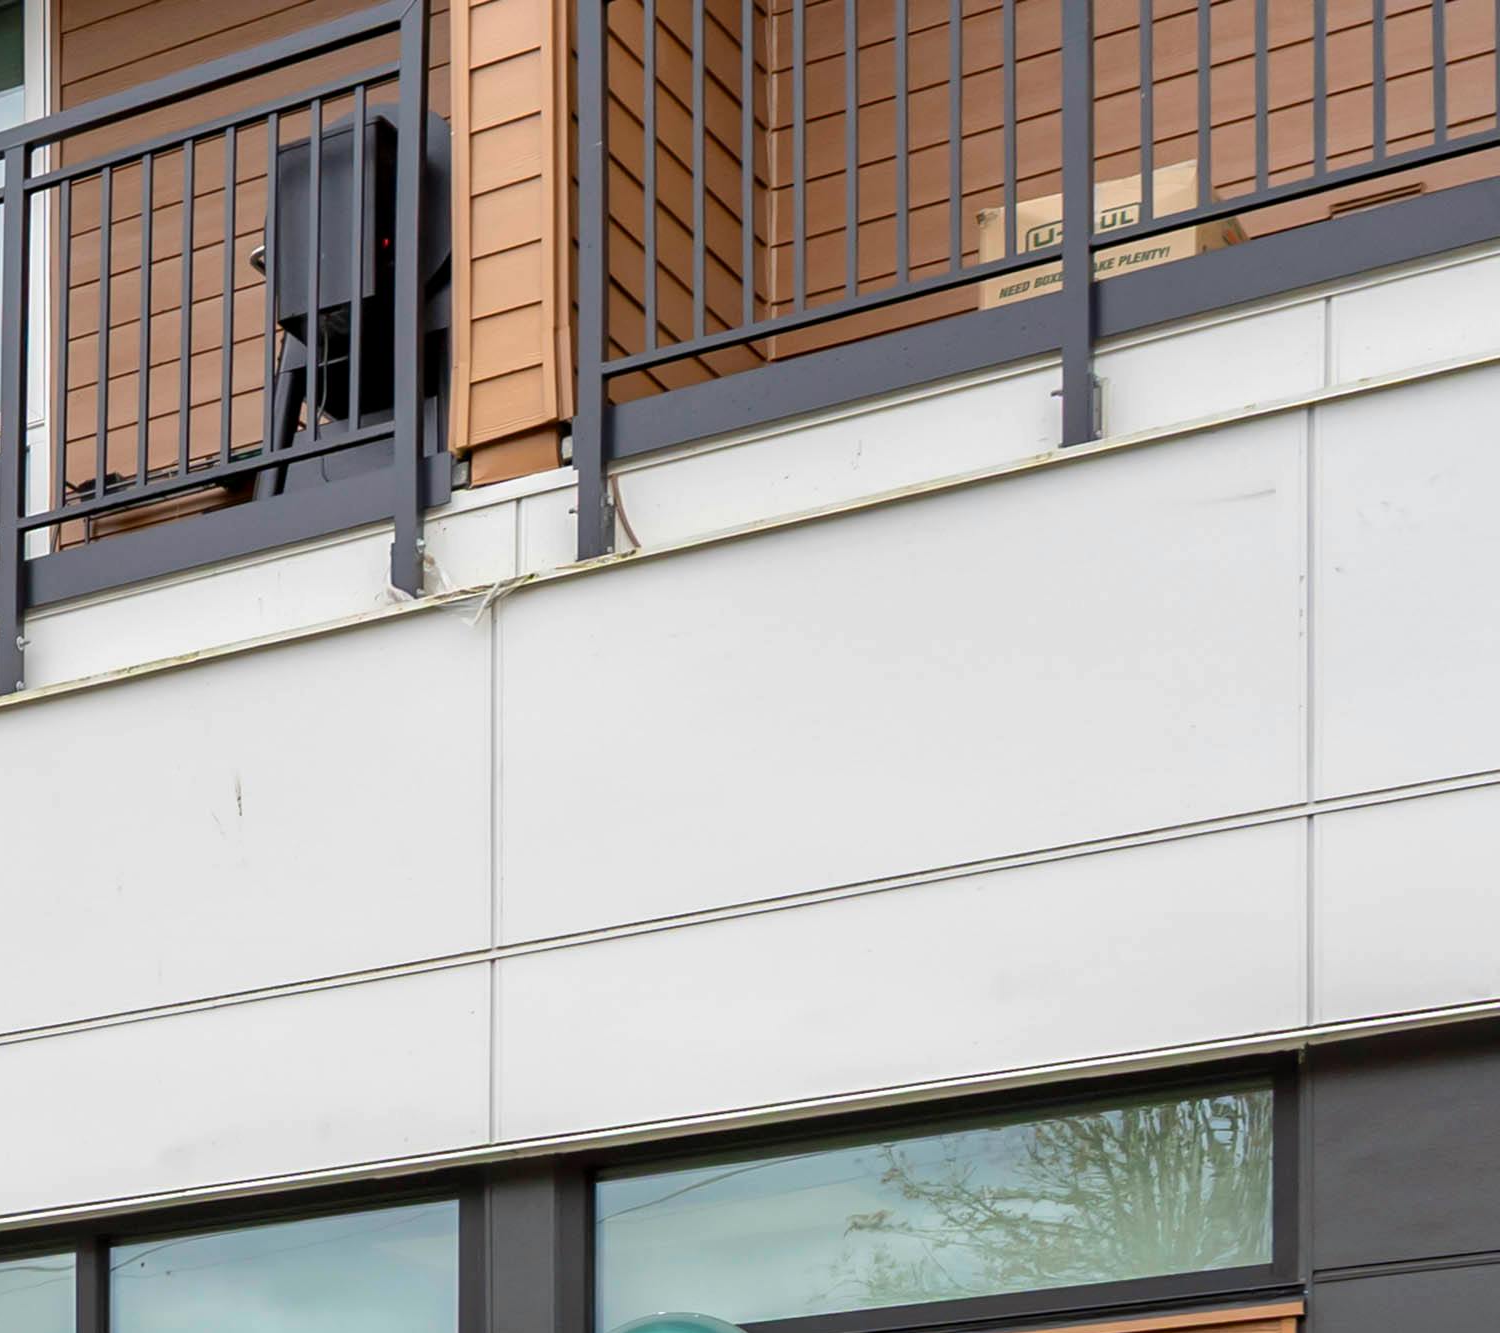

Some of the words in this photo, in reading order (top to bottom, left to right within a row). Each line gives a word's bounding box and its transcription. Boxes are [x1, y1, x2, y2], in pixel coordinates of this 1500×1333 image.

[1033, 210, 1133, 247] U-UL
[999, 281, 1030, 299] NEED
[1093, 258, 1114, 272] AKE
[1118, 246, 1171, 267] PLENTY!
